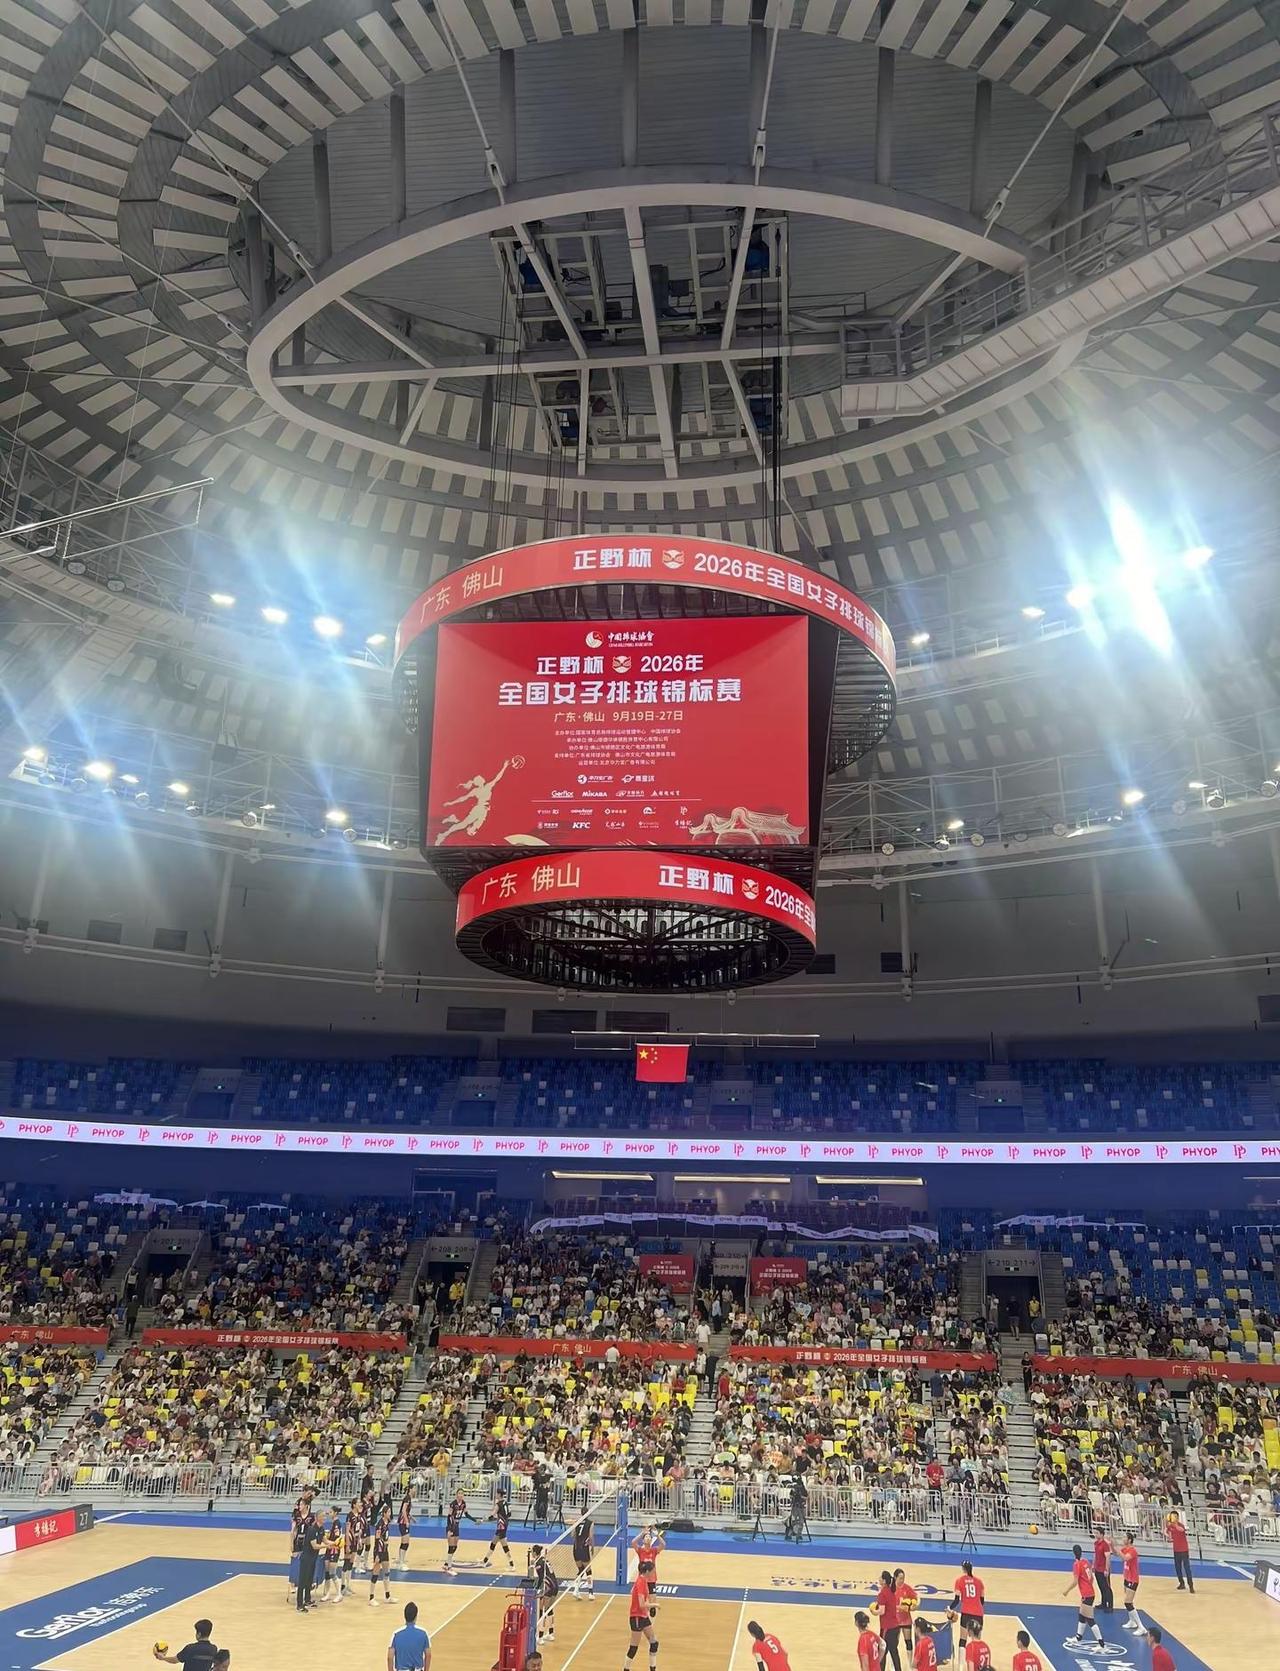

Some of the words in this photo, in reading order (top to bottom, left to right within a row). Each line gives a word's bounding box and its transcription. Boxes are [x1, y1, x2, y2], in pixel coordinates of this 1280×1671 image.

[419, 585, 452, 625] 广东
[462, 565, 503, 600] 佛山
[573, 547, 652, 571] 正野杯
[694, 553, 890, 653] 2026年全国女子排球锦标
[536, 656, 604, 675] 正野杯
[641, 654, 703, 672] 2026年
[498, 679, 742, 706] 全国女子排球锦标赛
[613, 710, 683, 721] 9月19日-27日
[572, 821, 591, 829] KFC
[482, 873, 517, 905] 广东
[531, 862, 580, 893] 佛山
[658, 865, 734, 896] 正野杯
[19, 1123, 53, 1134] PHYOP
[92, 1128, 124, 1138] PHYOP
[163, 1131, 193, 1141] PHYOP
[231, 1134, 262, 1143] PHYOP
[299, 1136, 328, 1146] PHYOP
[364, 1138, 395, 1147] PHYOP
[430, 1140, 459, 1149] PHYOP
[496, 1141, 525, 1151] PHYOP
[560, 1142, 590, 1152] PHYOP
[625, 1143, 654, 1153] PHYOP
[691, 1144, 721, 1154] PHYOP
[756, 1145, 786, 1155] PHYOP
[823, 1146, 854, 1156] PHYOP
[891, 1147, 924, 1157] PHYOP
[961, 1148, 993, 1157] PHYOP
[1033, 1148, 1066, 1157] PHYOP
[1105, 1147, 1141, 1157] PHYOP
[1182, 1146, 1217, 1157] PHYOP
[553, 1343, 570, 1352] 广东
[574, 1343, 592, 1353] 佛山
[1172, 1365, 1192, 1376] 广东
[1198, 1365, 1218, 1376] 佛山
[80, 1512, 88, 1526] 27
[578, 1524, 585, 1536] 7
[965, 1584, 976, 1598] 19
[767, 1639, 779, 1654] 5
